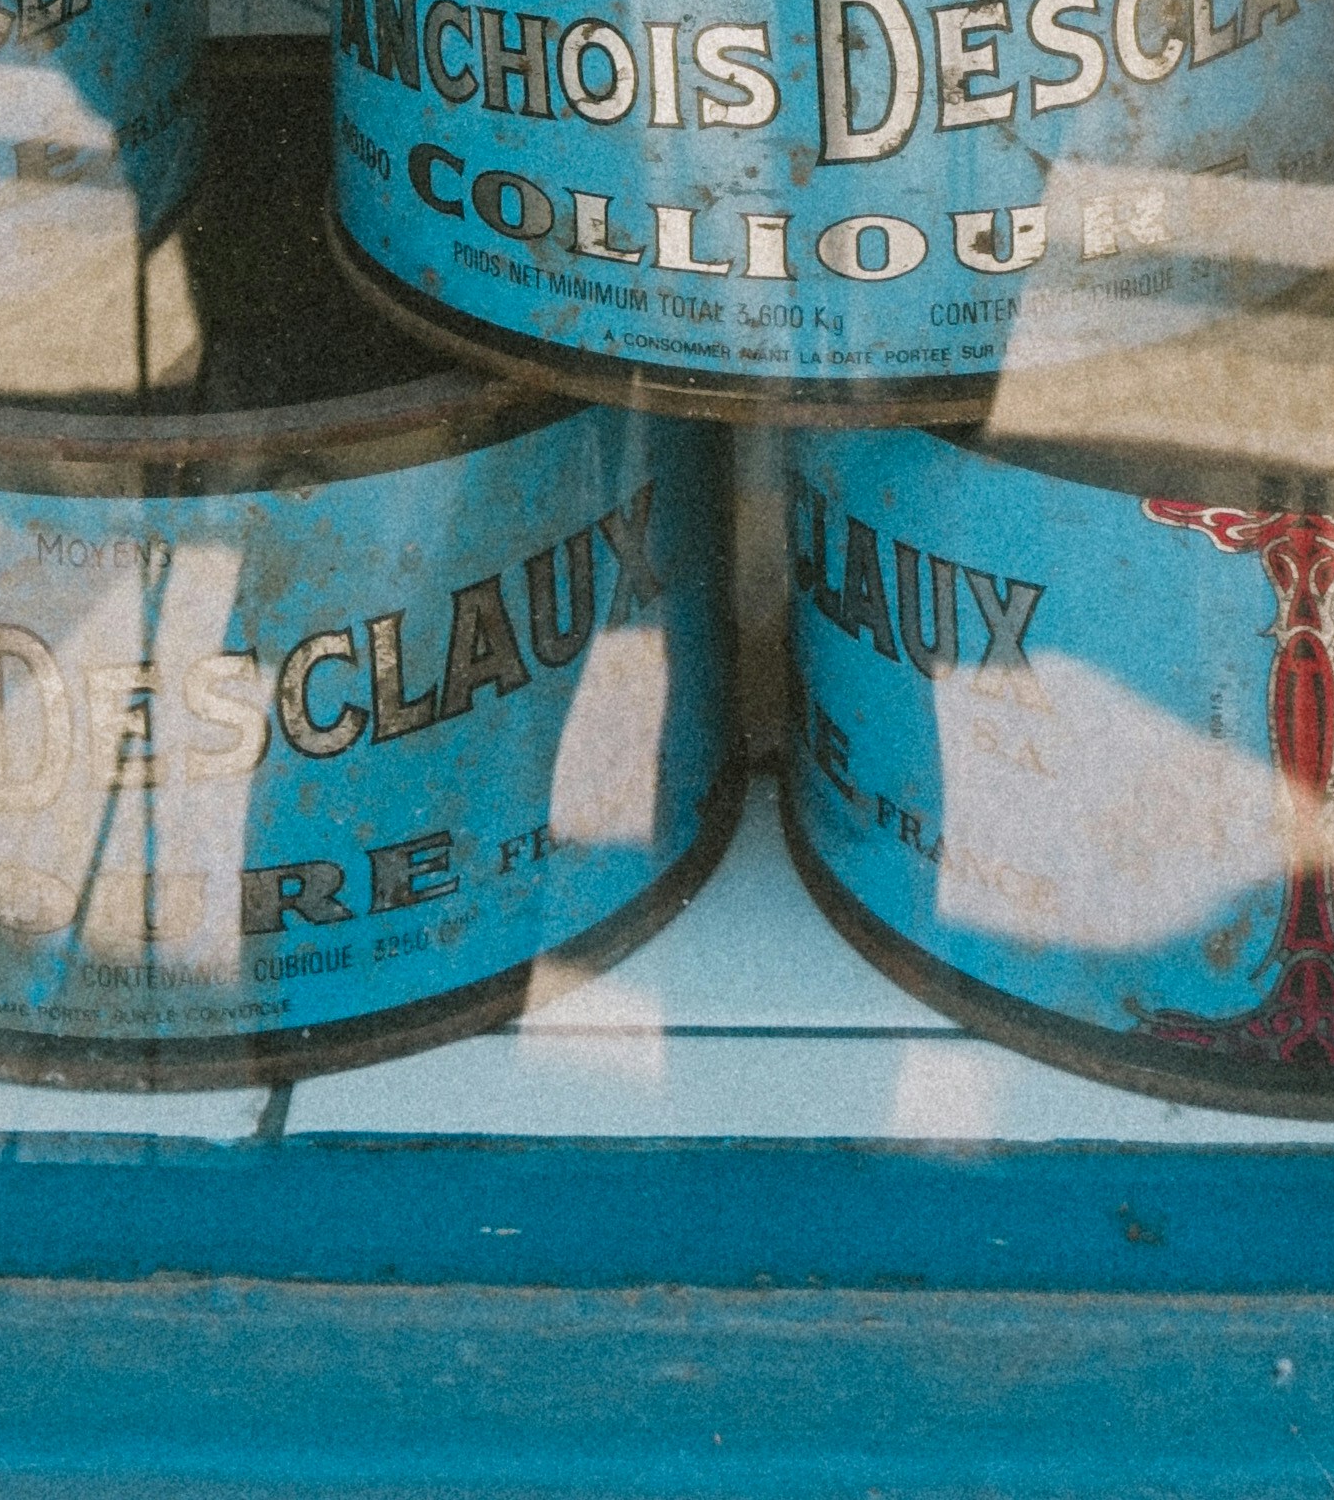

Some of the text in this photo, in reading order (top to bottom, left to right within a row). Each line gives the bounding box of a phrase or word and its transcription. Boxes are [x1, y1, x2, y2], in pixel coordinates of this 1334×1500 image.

[406, 142, 1250, 283] COLLIOUR
[453, 239, 502, 279] POIDS
[508, 259, 544, 292] NET
[547, 269, 649, 312] MINIMUM
[657, 292, 724, 324] TOTAL
[812, 306, 846, 337] Kg
[623, 331, 731, 360] CONSOMMER
[800, 349, 822, 365] LA
[831, 348, 874, 366] DATE
[884, 345, 952, 363] PORTEE
[961, 344, 995, 360] SUR
